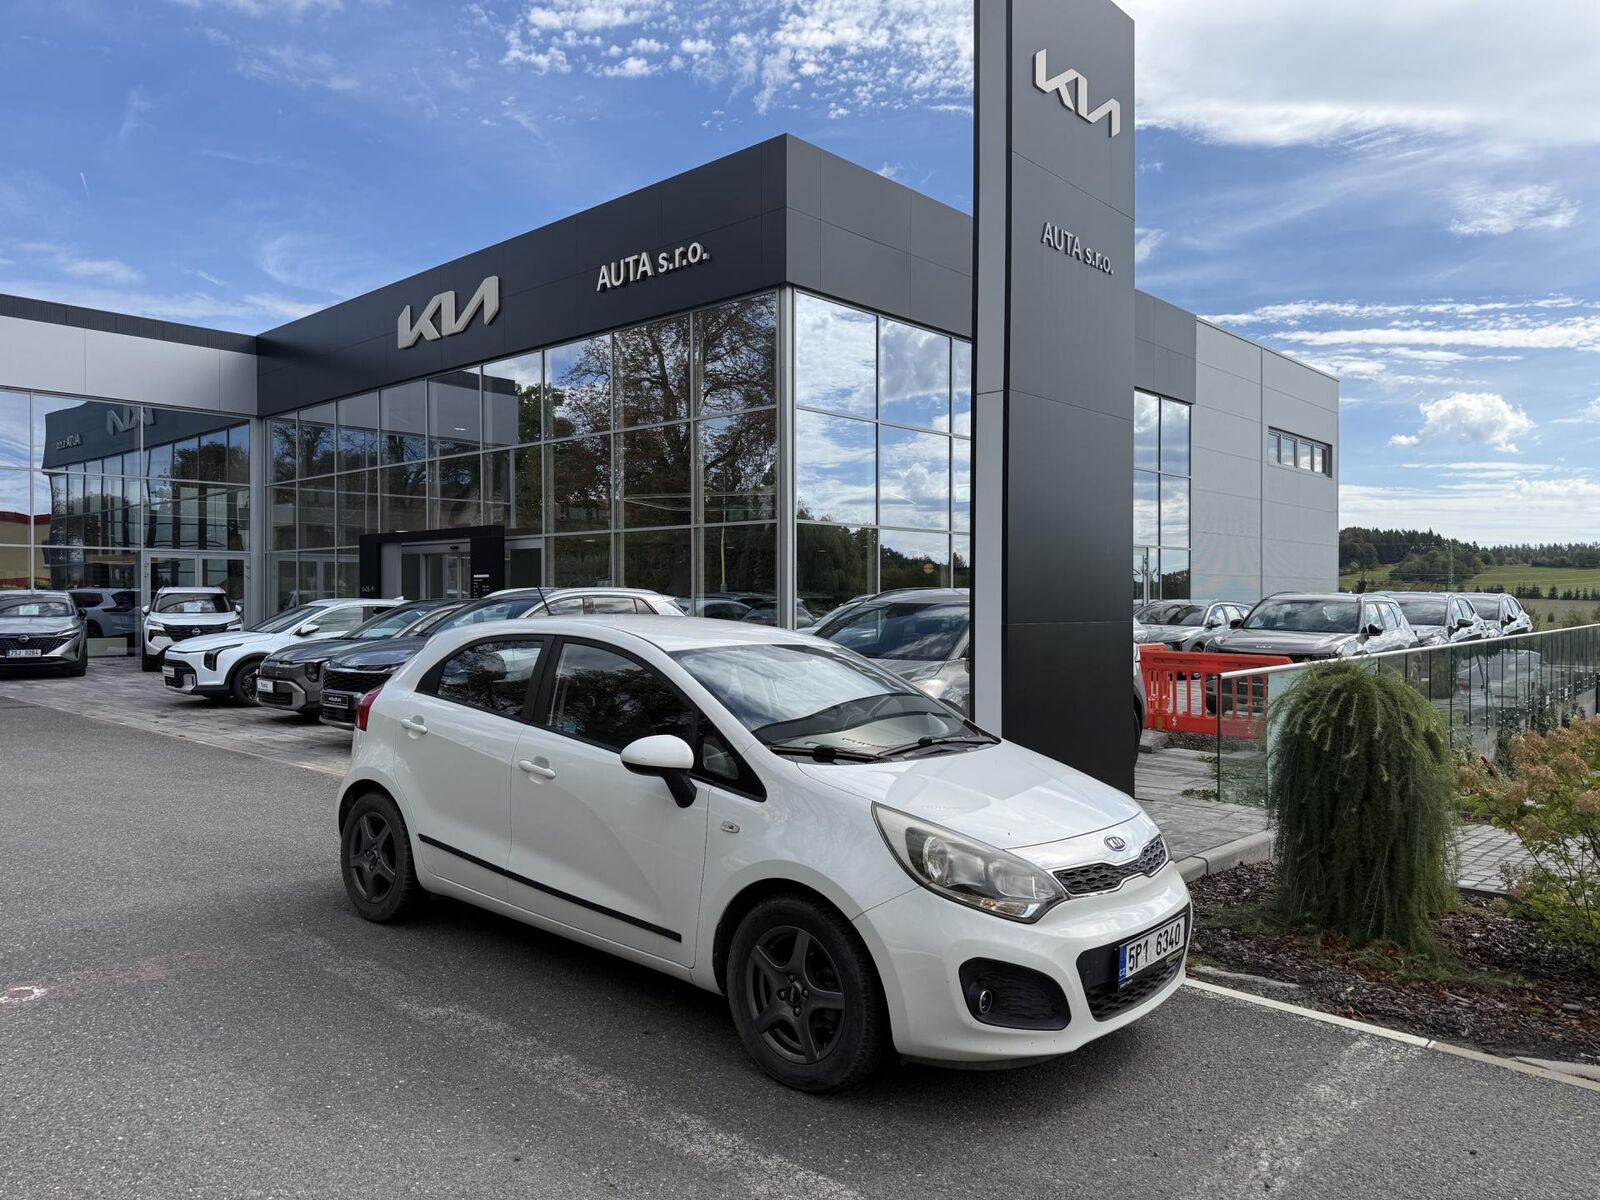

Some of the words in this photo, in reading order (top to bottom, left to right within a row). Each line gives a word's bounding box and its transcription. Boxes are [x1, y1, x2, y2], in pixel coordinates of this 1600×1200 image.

[1033, 48, 1120, 138] KIA
[597, 252, 653, 291] AUTA
[658, 242, 709, 273] s.r.o.
[1041, 221, 1082, 260] AUTA
[1084, 247, 1114, 275] s.r.o.
[397, 275, 499, 349] KIA
[1105, 837, 1125, 850] KIA
[1128, 939, 1148, 971] 5P1
[1156, 923, 1181, 956] 6340
